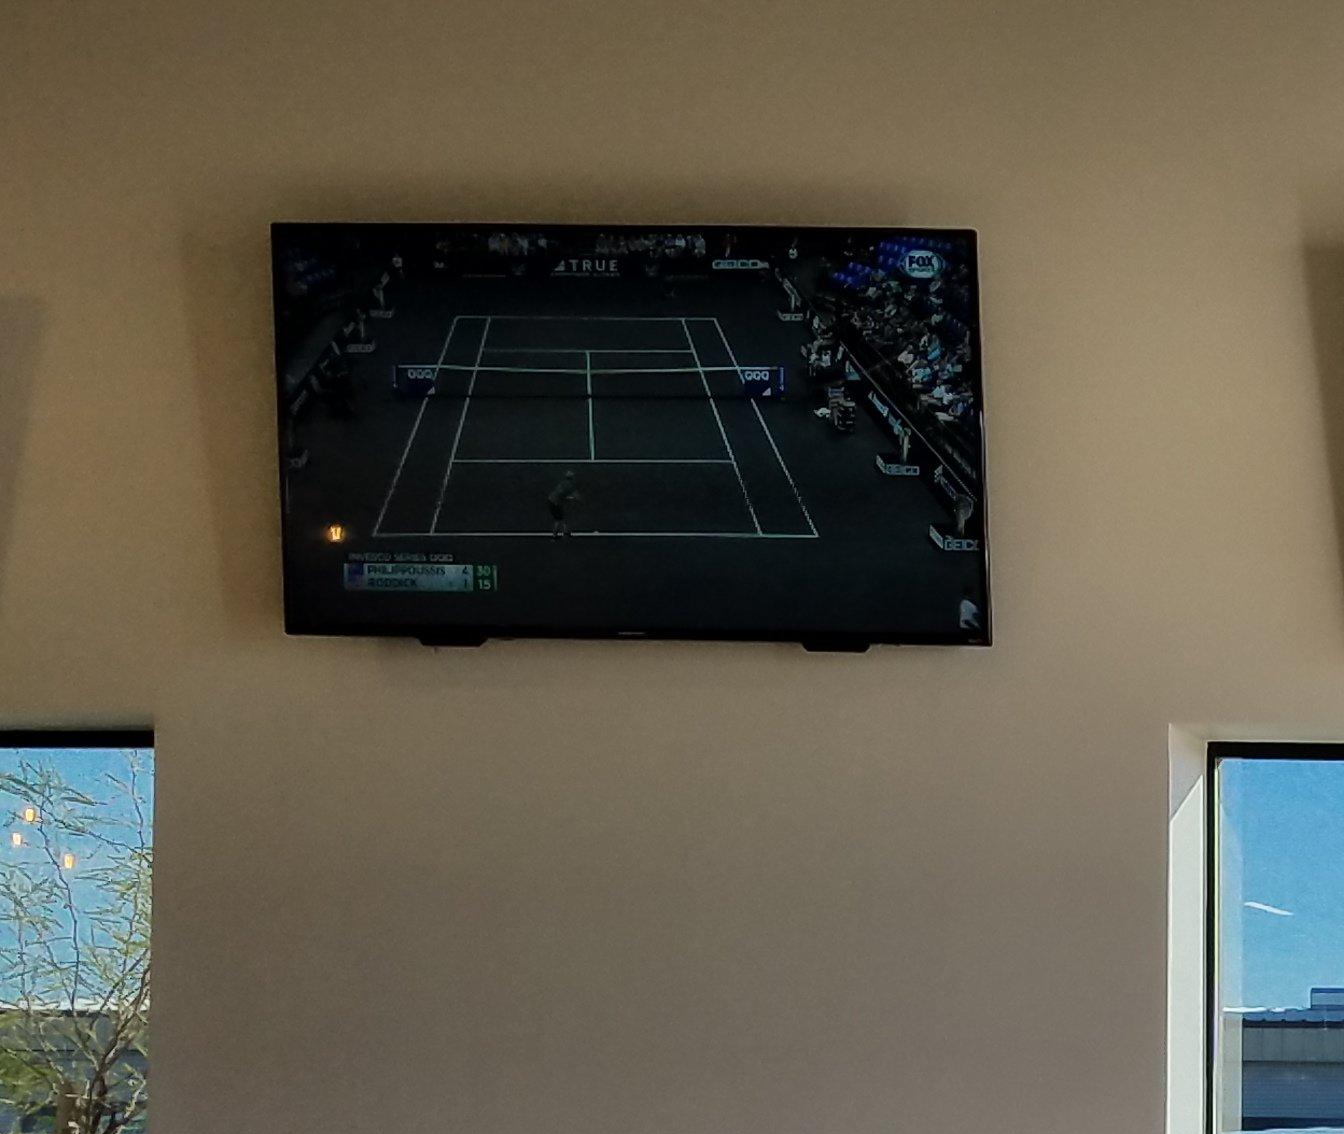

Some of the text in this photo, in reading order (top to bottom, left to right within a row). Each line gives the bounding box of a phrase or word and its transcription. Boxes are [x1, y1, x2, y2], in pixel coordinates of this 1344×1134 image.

[568, 259, 618, 271] TRUE
[908, 256, 934, 267] FOX
[478, 579, 491, 590] 15
